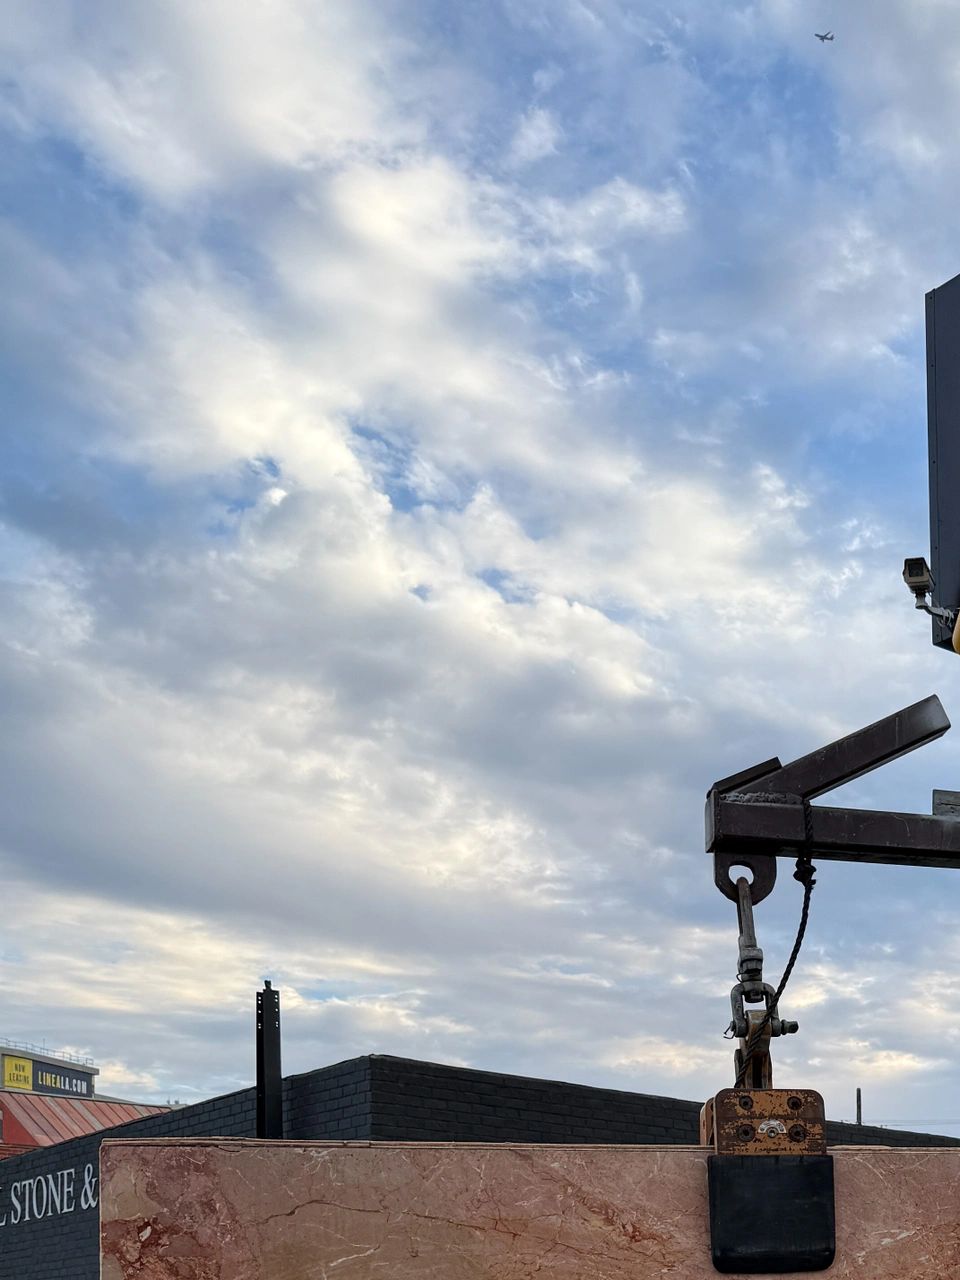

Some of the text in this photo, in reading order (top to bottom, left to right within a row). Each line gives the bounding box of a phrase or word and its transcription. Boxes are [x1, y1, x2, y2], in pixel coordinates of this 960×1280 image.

[38, 1070, 87, 1095] LINEALA.COM
[10, 1168, 76, 1225] STONE
[80, 1163, 99, 1210] &
